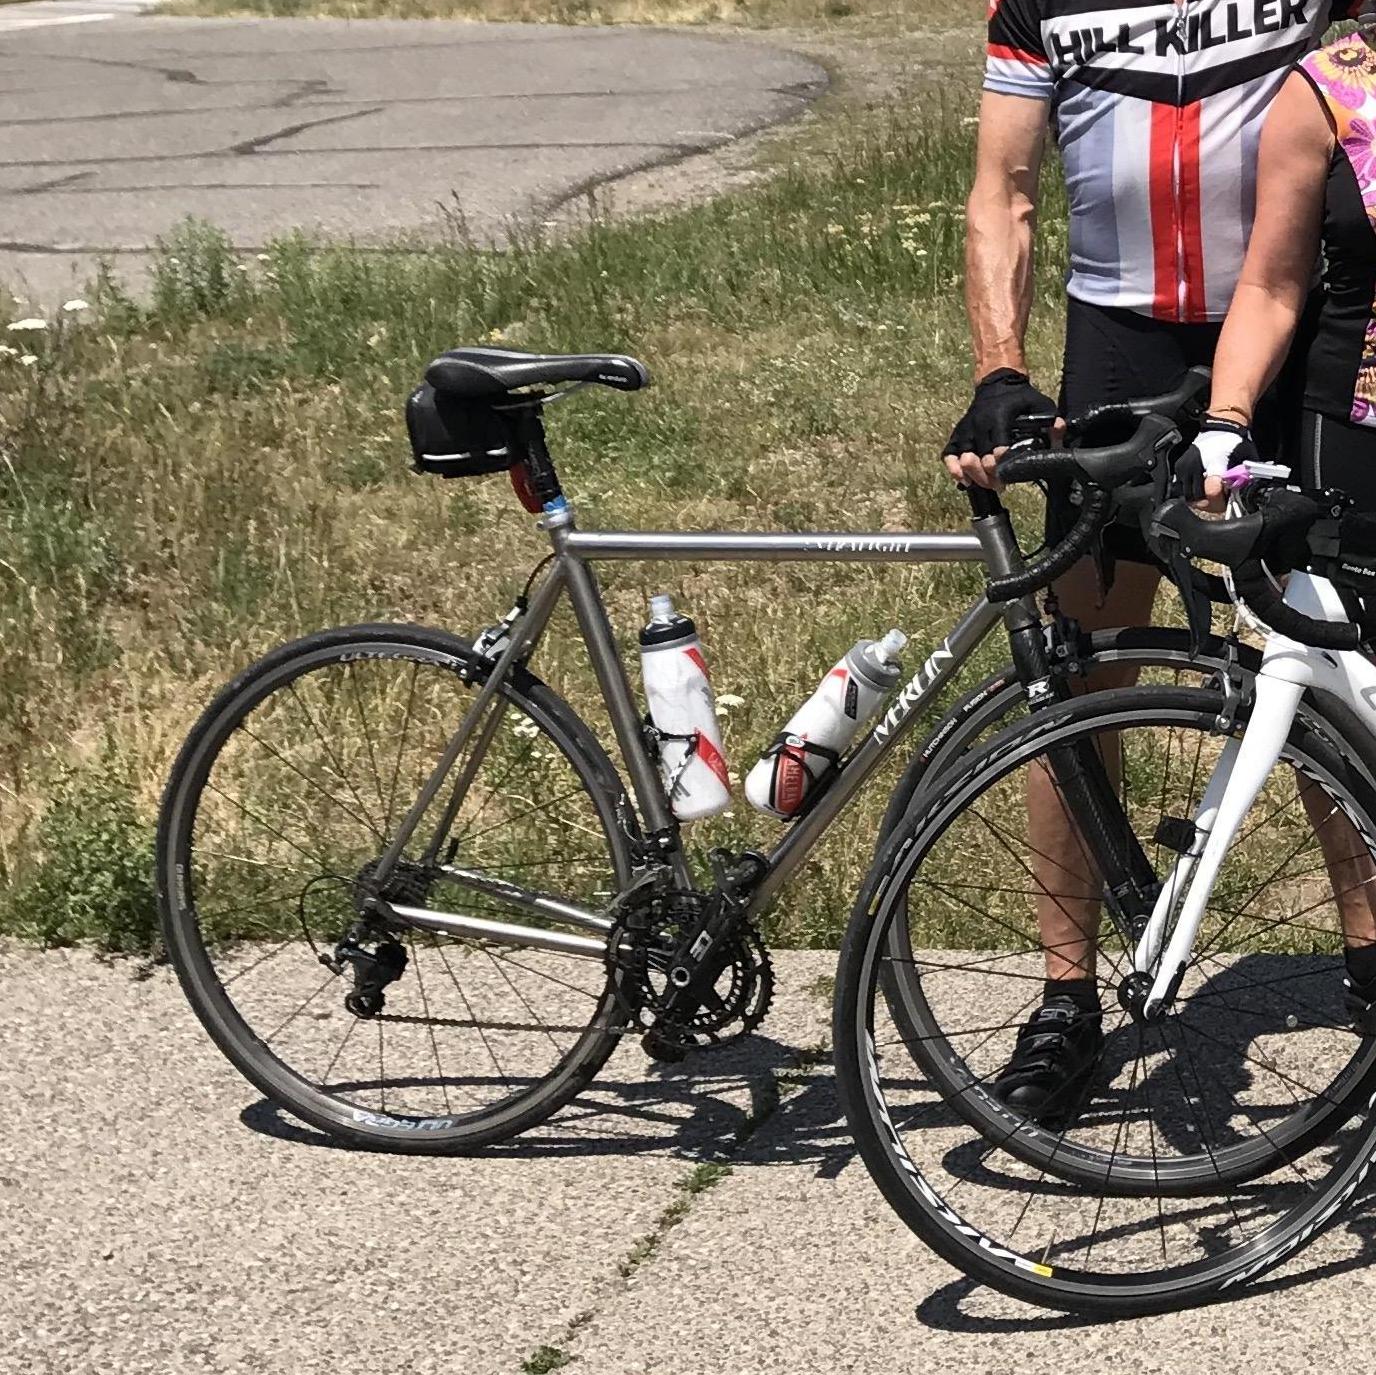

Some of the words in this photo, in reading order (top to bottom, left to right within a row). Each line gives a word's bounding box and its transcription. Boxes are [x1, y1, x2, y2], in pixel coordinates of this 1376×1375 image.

[1052, 23, 1144, 65] HILL
[873, 637, 953, 745] MERLIN
[922, 717, 958, 758] HUTCHINSON
